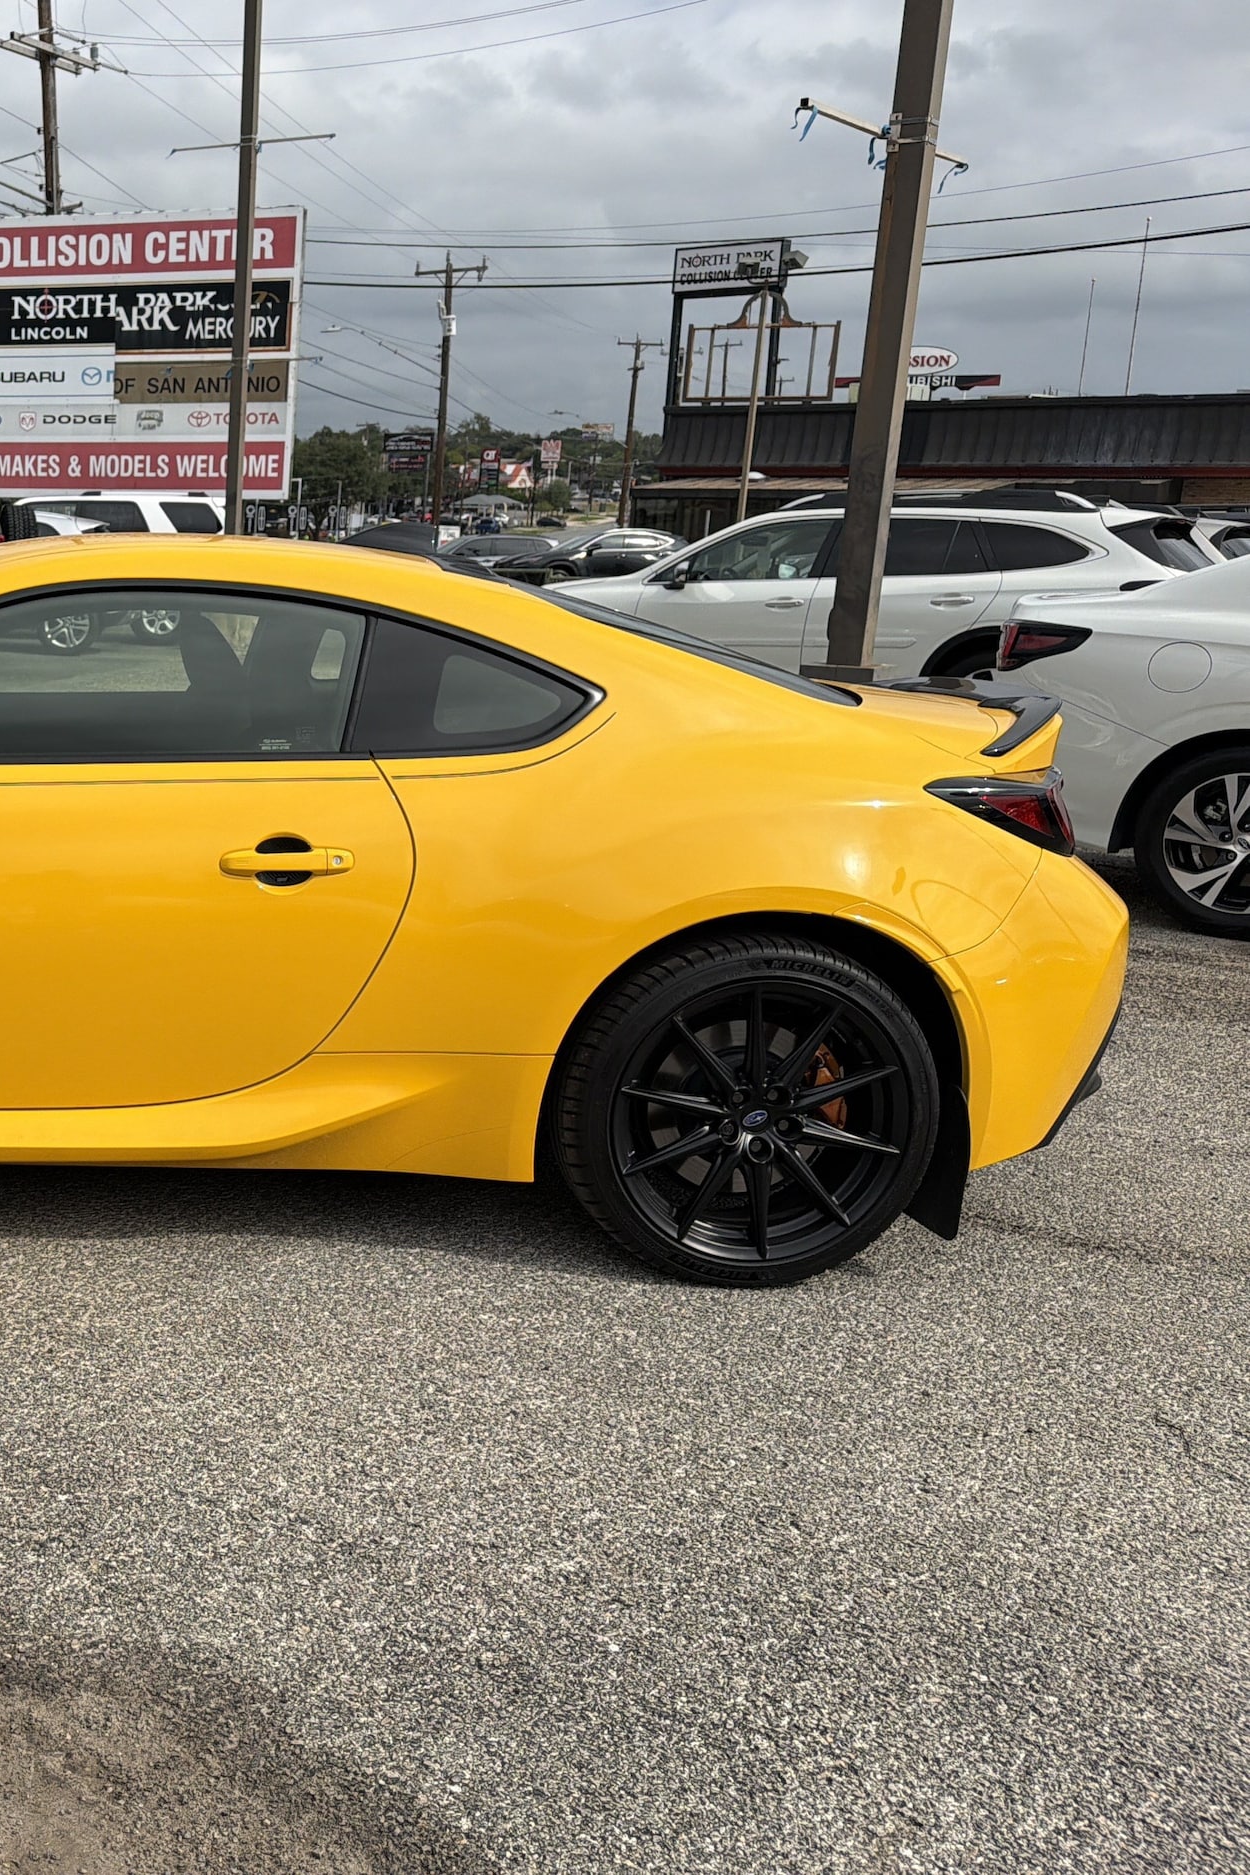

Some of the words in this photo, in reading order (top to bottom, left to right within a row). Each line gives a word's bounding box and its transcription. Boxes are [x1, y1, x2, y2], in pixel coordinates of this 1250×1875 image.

[680, 253, 731, 269] NORTH
[11, 291, 117, 321] NORTH
[11, 326, 88, 341] LINCOLN
[147, 377, 185, 394] SAN
[194, 375, 281, 393] ANTNIO
[43, 414, 118, 425] DODGE
[213, 412, 280, 425] TOOTA
[67, 455, 82, 477] &
[89, 454, 169, 477] MODELS
[770, 959, 851, 987] MICHELIN
